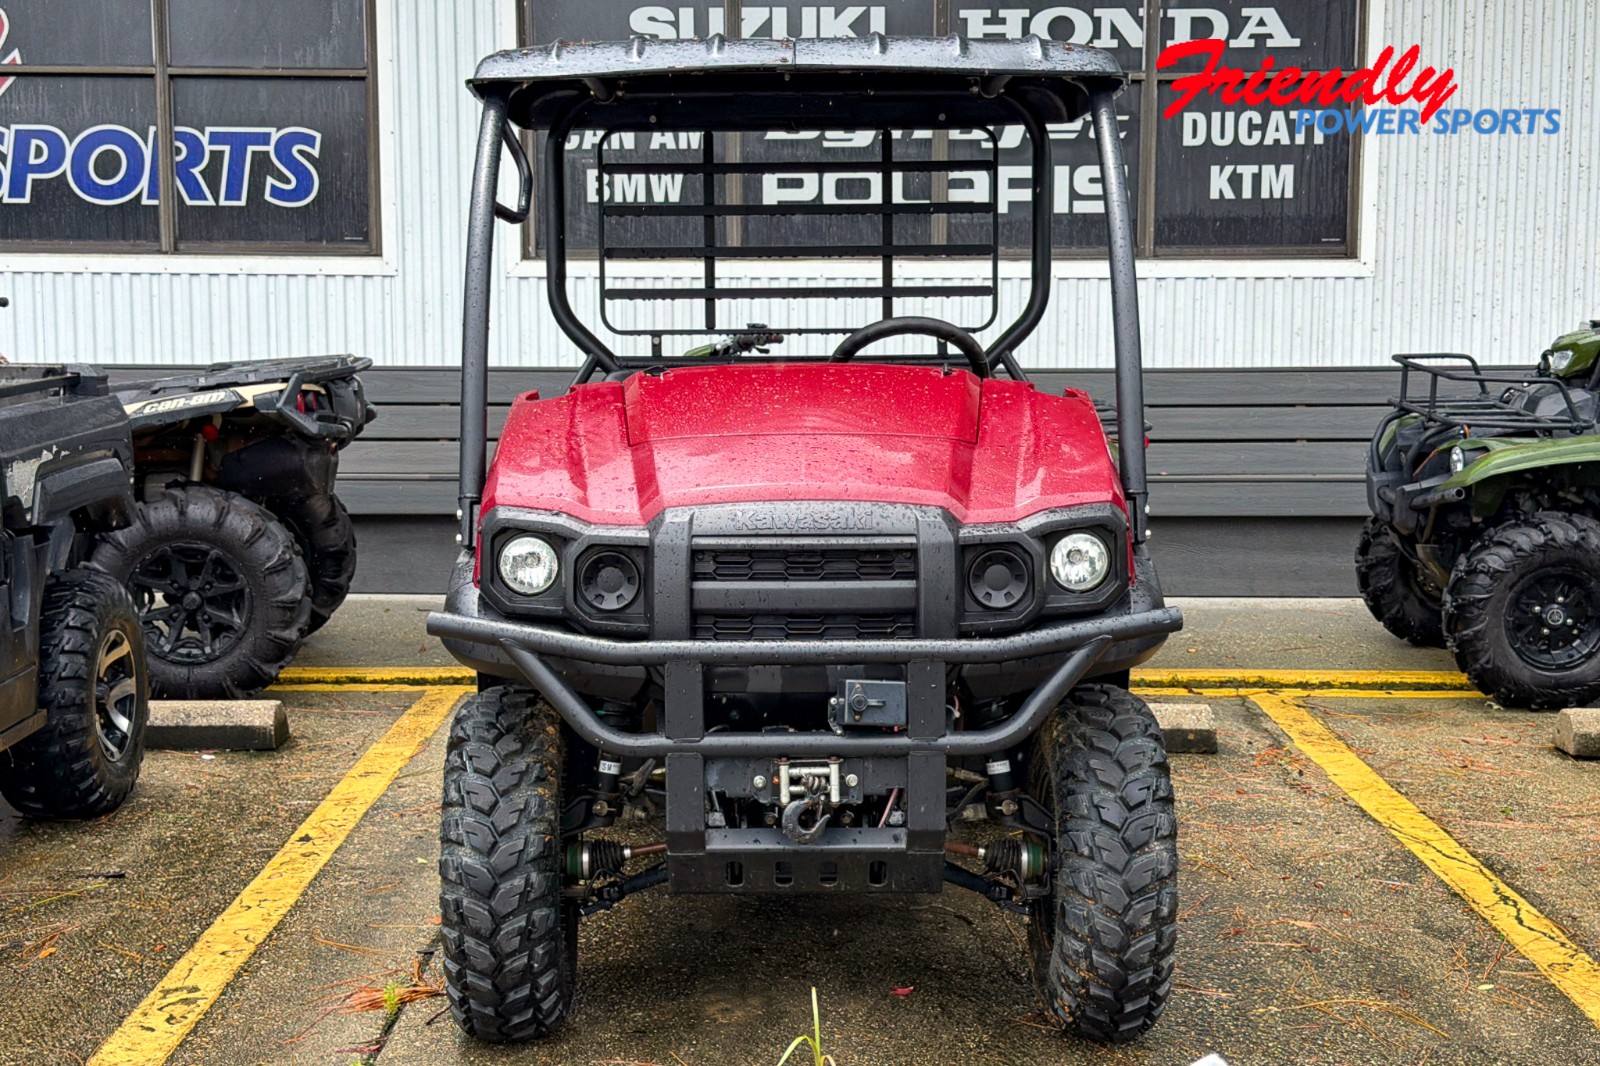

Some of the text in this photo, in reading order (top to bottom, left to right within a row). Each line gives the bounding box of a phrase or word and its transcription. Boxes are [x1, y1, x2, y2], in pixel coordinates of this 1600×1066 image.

[629, 6, 886, 40] SUZUKI
[959, 7, 1301, 48] HONDA
[1182, 110, 1325, 147] DUCATI
[0, 124, 322, 208] PORTS
[1209, 164, 1295, 200] KTM
[586, 168, 684, 203] BMW
[735, 510, 874, 531] Kawasaki
